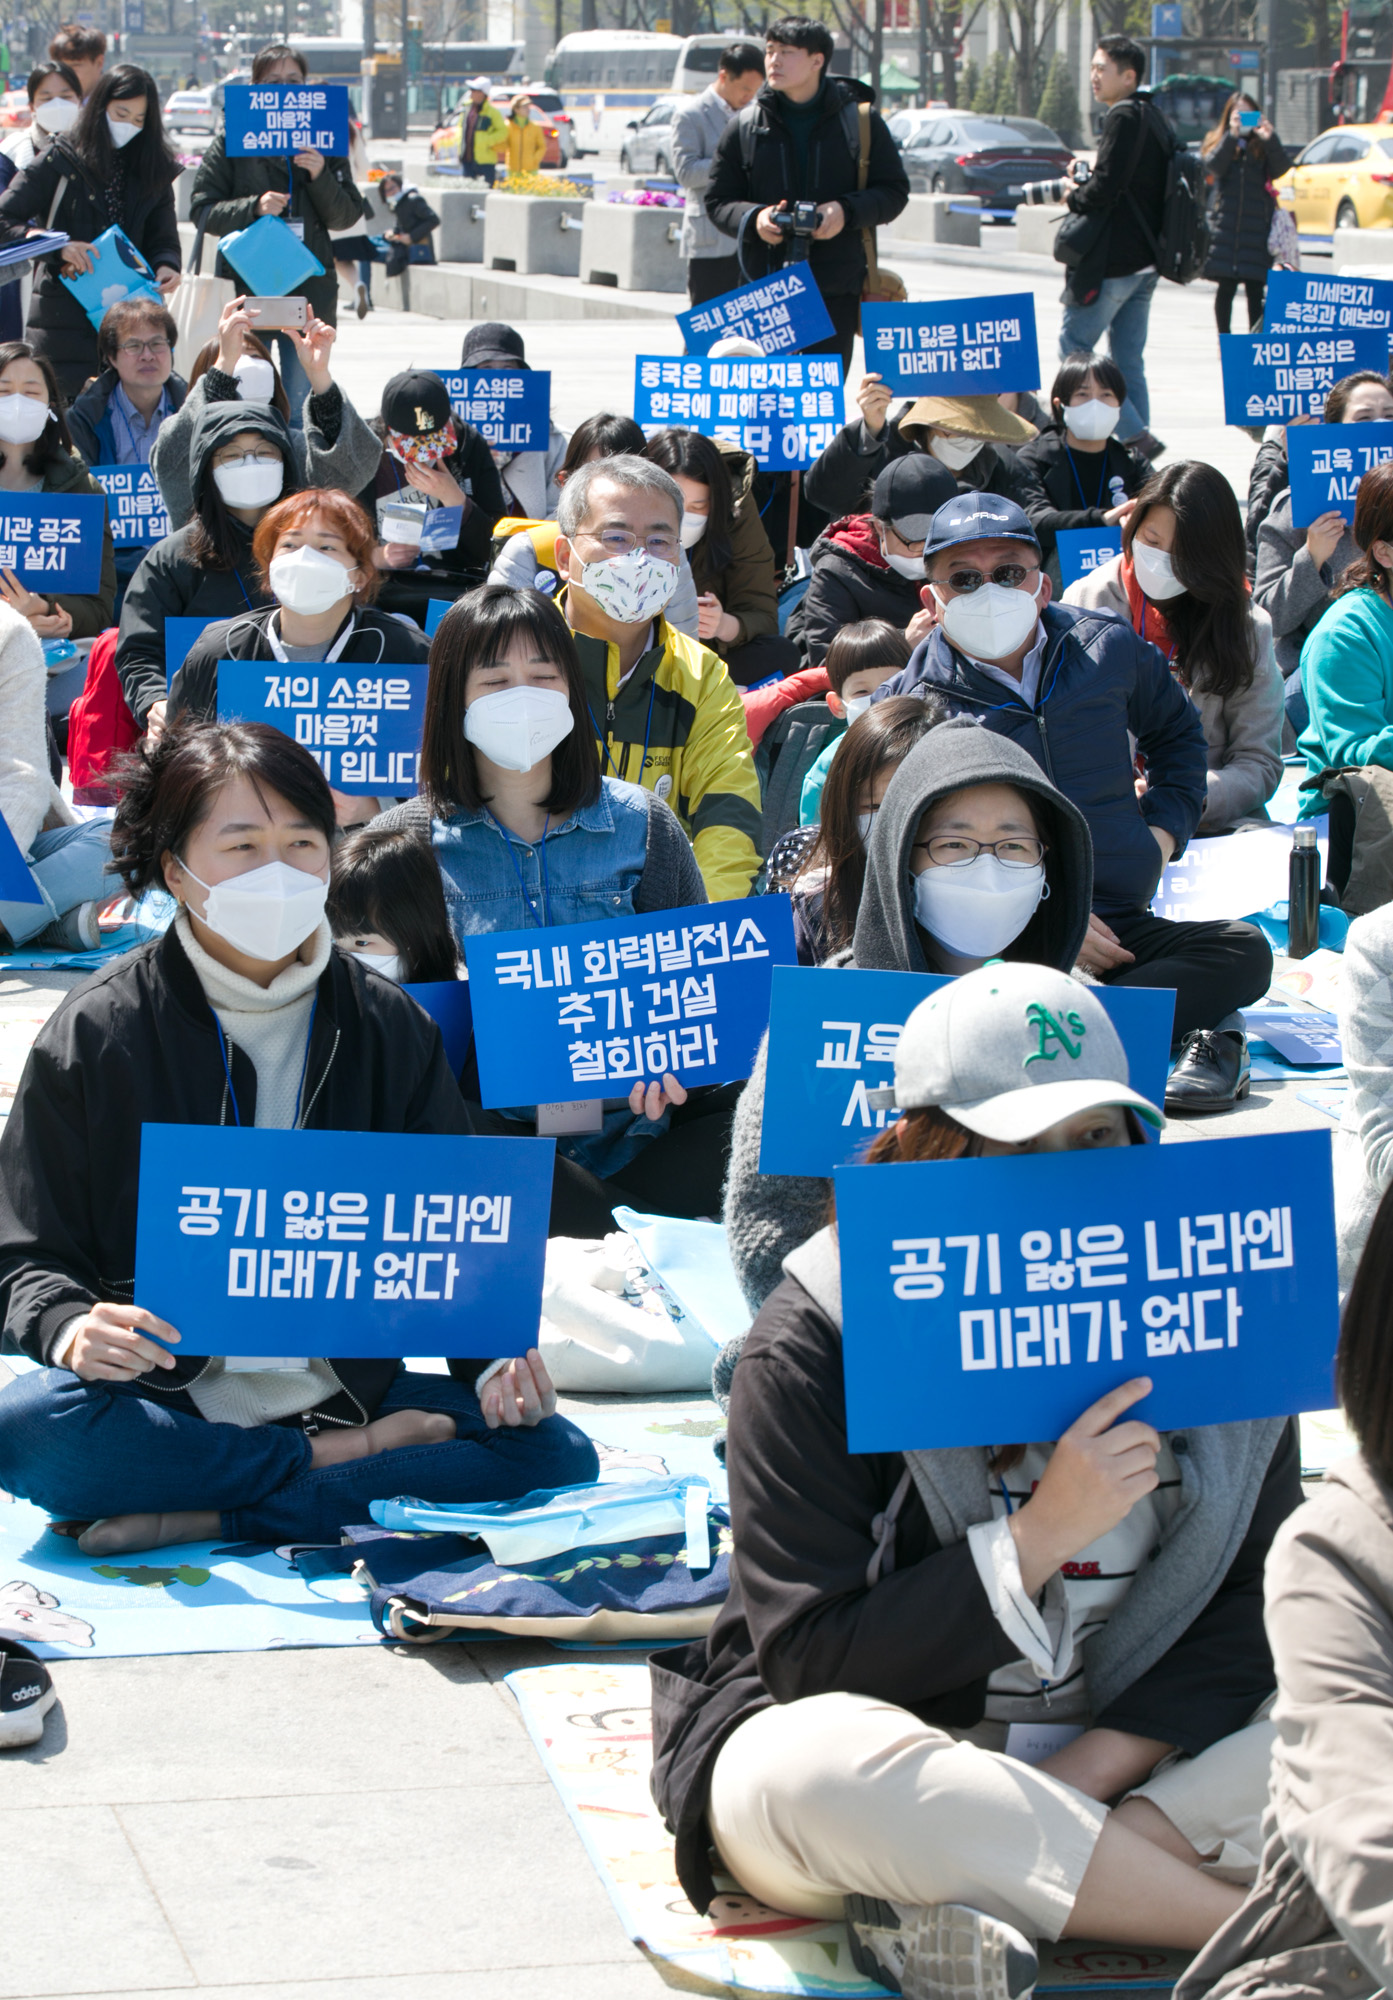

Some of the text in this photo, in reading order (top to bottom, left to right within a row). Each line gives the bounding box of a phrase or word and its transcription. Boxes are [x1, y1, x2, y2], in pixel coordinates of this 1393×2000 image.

[249, 91, 327, 110] 저의 소원은
[266, 111, 311, 129] 마음껏
[242, 131, 335, 149] 숨쉬기 입니다
[689, 274, 806, 333] 국내 화력발전소
[1305, 281, 1374, 306] 미세먼지
[753, 303, 791, 333] 건설
[1285, 302, 1336, 325] 측정과
[1339, 306, 1391, 329] 예보의
[876, 318, 1021, 350] 공기 잃은 나라엔
[898, 346, 1002, 375] 미래가 없다
[1252, 340, 1356, 366] 저의 소원은
[473, 378, 524, 398] 소원은
[641, 361, 840, 389] 중국은 미세먼지로 인해
[1275, 366, 1334, 391] 마음껏
[454, 400, 505, 421] 마음껏
[650, 391, 835, 419] 한국에 피해주는 일을
[1246, 394, 1303, 417] 숨쉬기
[482, 423, 532, 444] 입니다
[1312, 448, 1353, 474] 교육
[97, 473, 133, 494] 저의
[1327, 475, 1361, 501] 시스
[38, 518, 81, 543] 공조
[110, 518, 143, 539] 쉬기
[23, 546, 66, 570] 설치
[264, 676, 411, 710] 저의 소원은
[295, 714, 378, 746] 마음껏
[340, 751, 422, 784] 입니다
[495, 917, 770, 990] 국내 화력발전소
[557, 973, 718, 1034] 추가 건설
[567, 1023, 719, 1082] 철회하라
[815, 1020, 905, 1070] 교육
[177, 1185, 512, 1243] 공기 잃은 나라엔
[889, 1206, 1294, 1300] 공기 잃은 나라엔
[227, 1248, 460, 1300] 미래가 없다
[959, 1287, 1243, 1371] 미래가 없다
